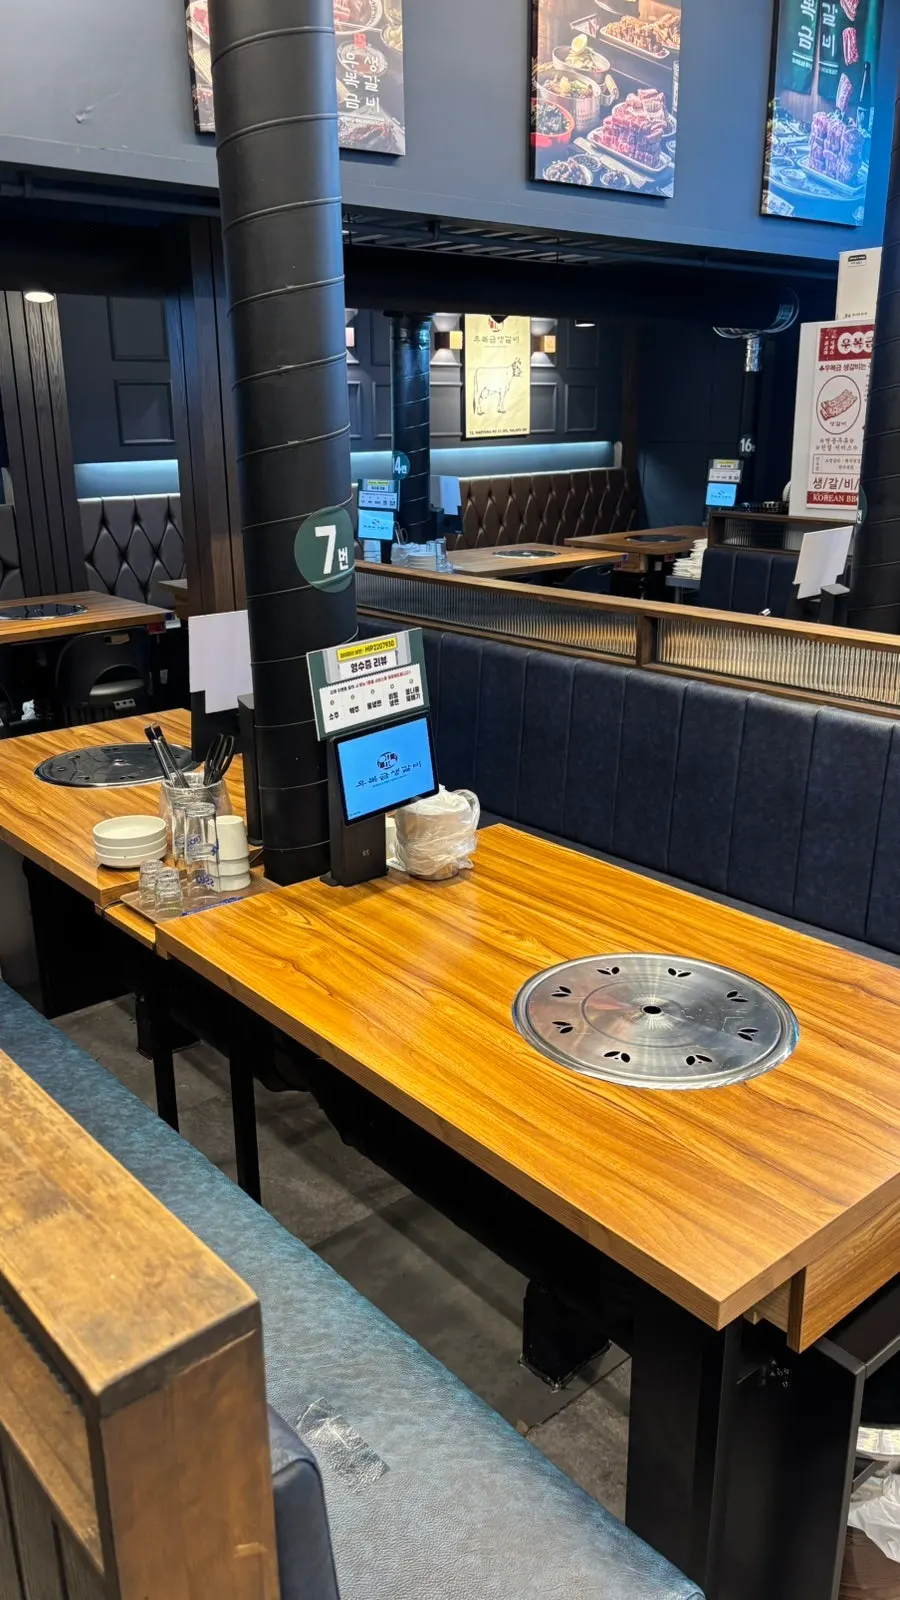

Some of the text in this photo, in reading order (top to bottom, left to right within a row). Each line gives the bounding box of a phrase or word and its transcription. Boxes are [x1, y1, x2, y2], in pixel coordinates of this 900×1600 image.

[343, 52, 360, 109] 우복금
[363, 56, 380, 112] 생갈비
[813, 492, 844, 502] KOREAN
[350, 656, 388, 673] 영수증 리뷰
